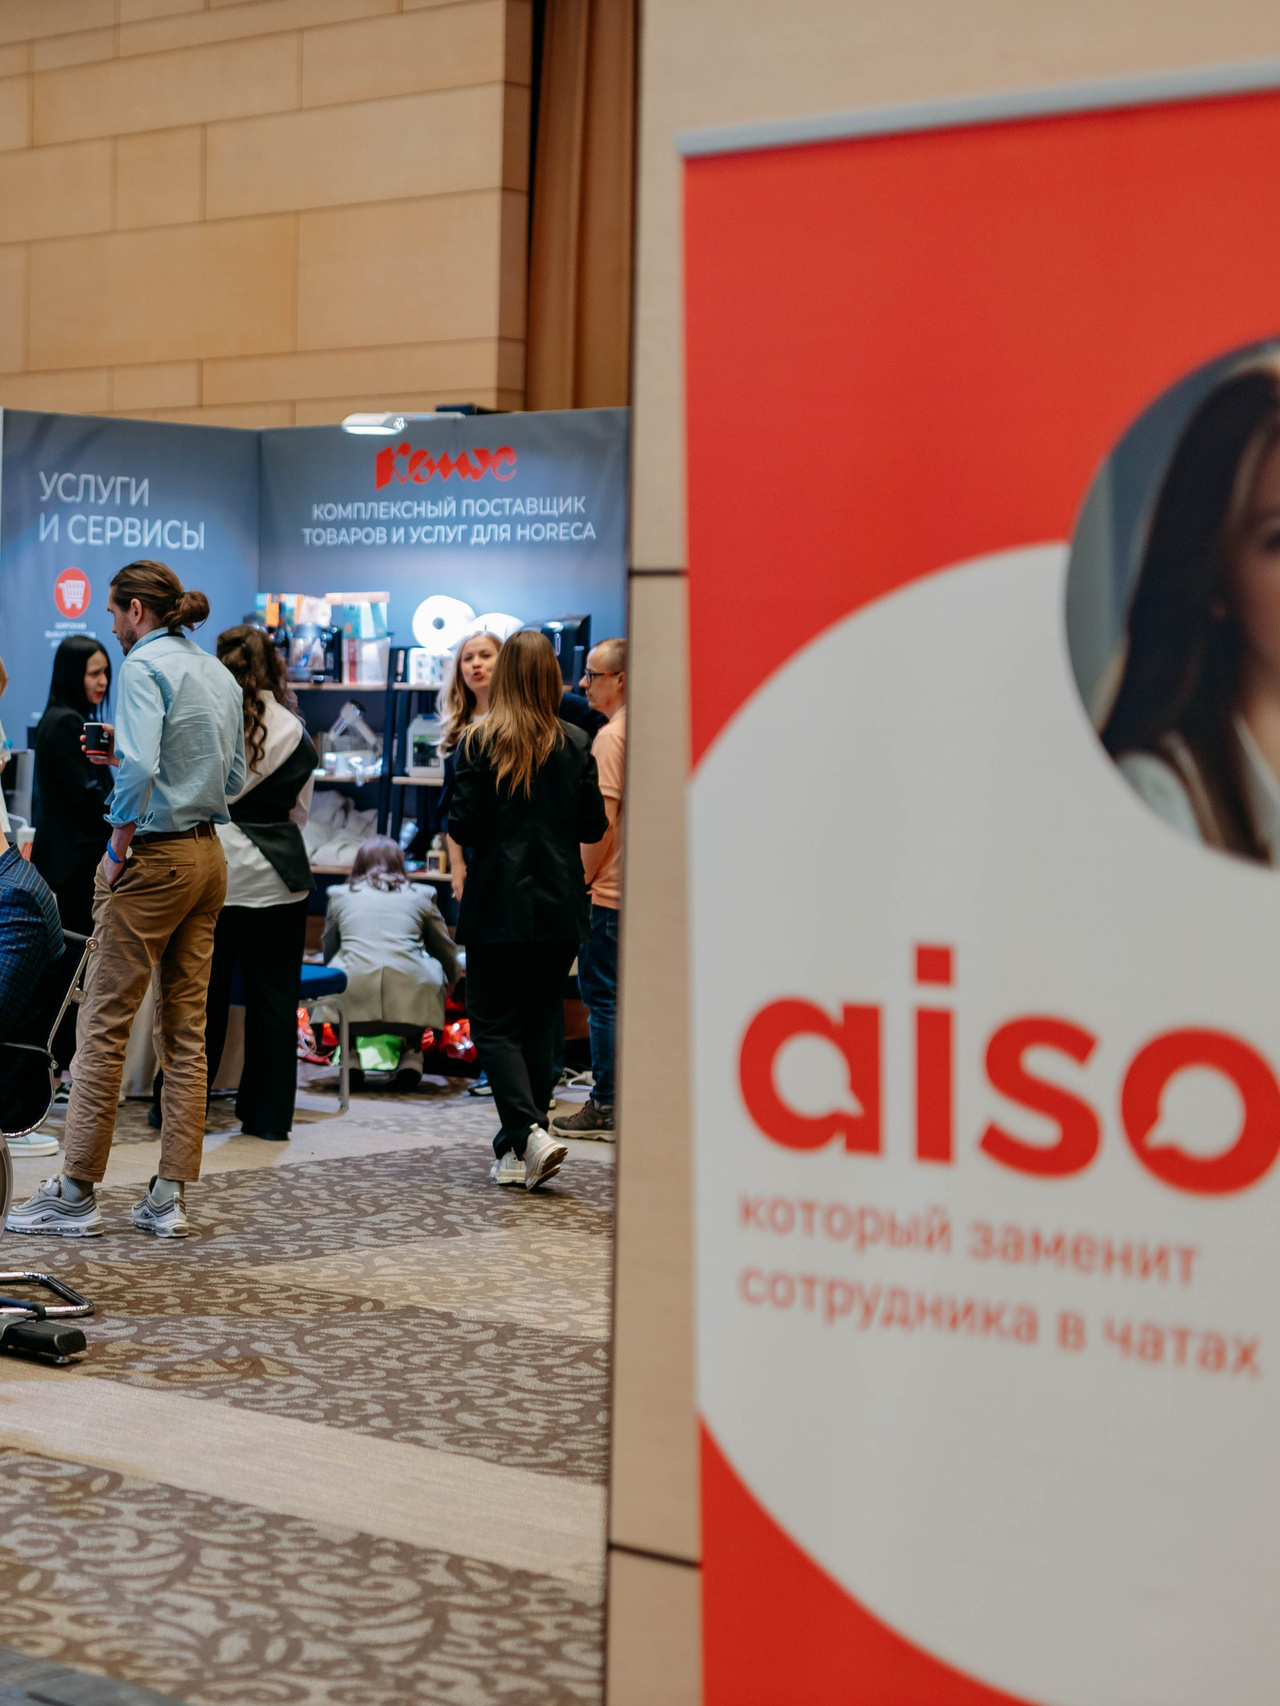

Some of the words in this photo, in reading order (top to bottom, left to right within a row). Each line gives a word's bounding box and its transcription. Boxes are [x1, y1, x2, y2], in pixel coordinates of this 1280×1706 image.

[38, 470, 150, 507] УСЛУГИ
[312, 495, 457, 521] КОМПЛЕКСНЫЙ
[462, 495, 587, 519] ПОСТАВЩИК
[39, 512, 59, 543] И
[67, 514, 205, 551] СЕРВИСЫ
[302, 527, 388, 546] ТОВАРОВ
[392, 526, 404, 543] И
[409, 524, 468, 544] УСЛУГ
[471, 523, 511, 545] ДЛЯ
[517, 521, 597, 542] HORECA
[736, 942, 1280, 1198] aiso
[738, 1195, 952, 1254] который
[967, 1218, 1202, 1290] заменит
[738, 1265, 1040, 1347] сотрудника
[1057, 1308, 1086, 1353] в
[1103, 1316, 1262, 1378] чатах
